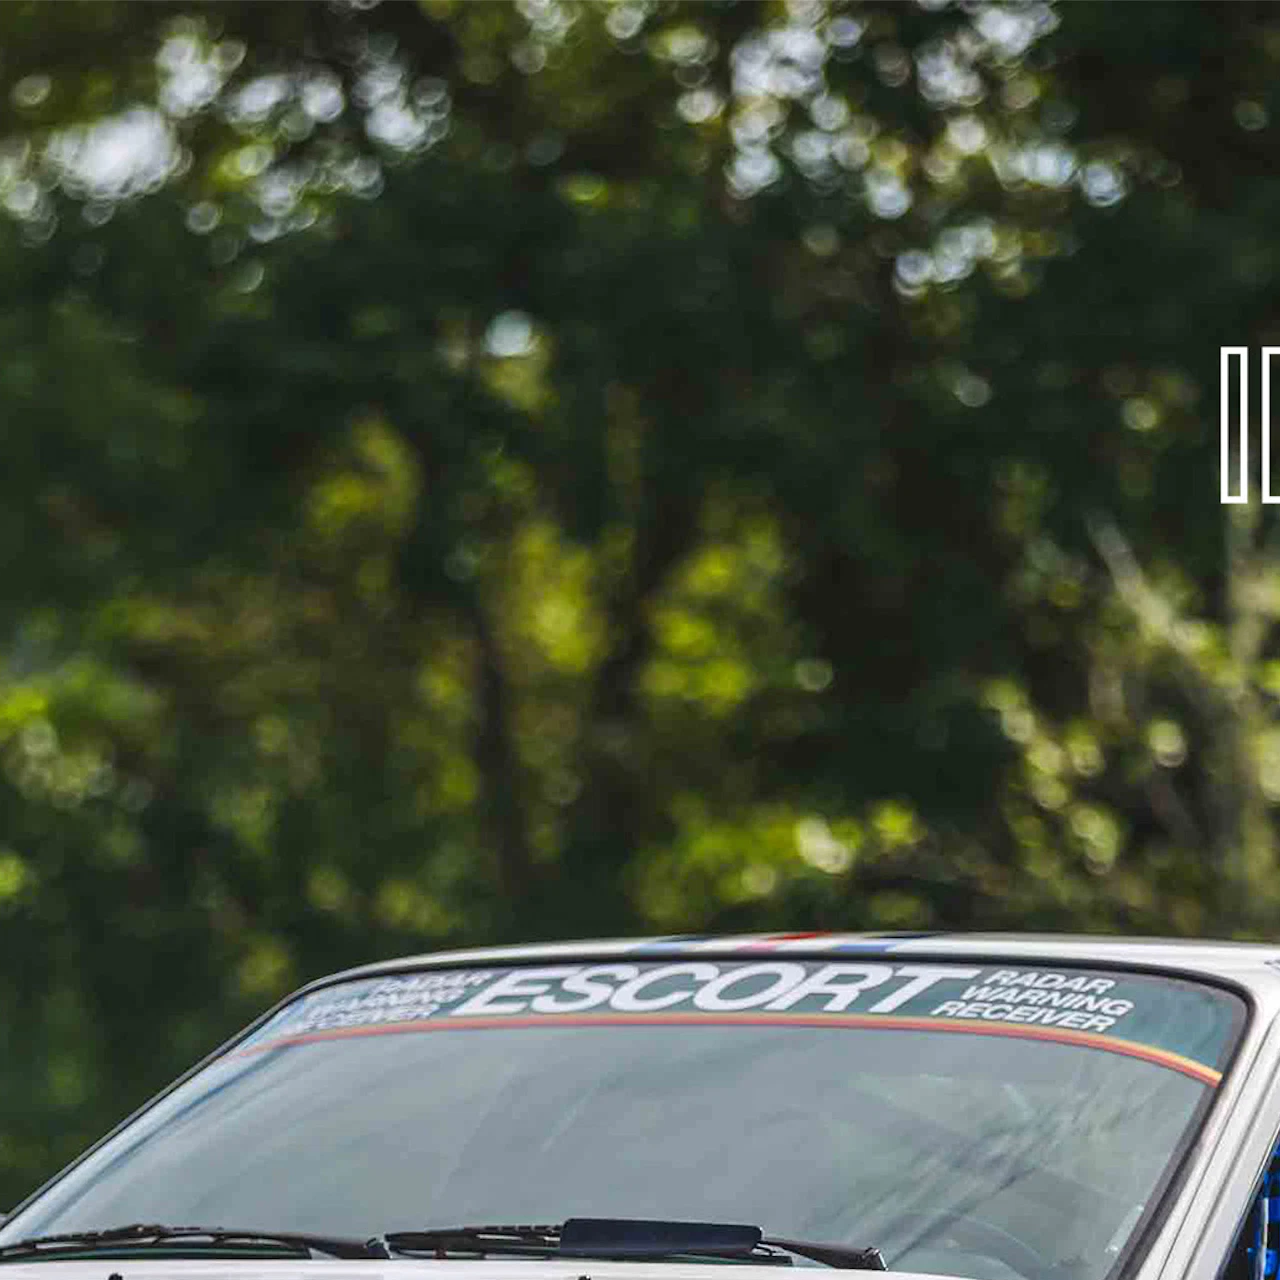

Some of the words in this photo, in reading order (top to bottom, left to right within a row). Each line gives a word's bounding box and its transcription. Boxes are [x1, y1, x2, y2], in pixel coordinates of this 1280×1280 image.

[449, 964, 982, 1016] ESCORT
[983, 969, 1116, 995] RADAR
[930, 1000, 1116, 1033] RECEIVER
[960, 985, 1135, 1016] WARNING
